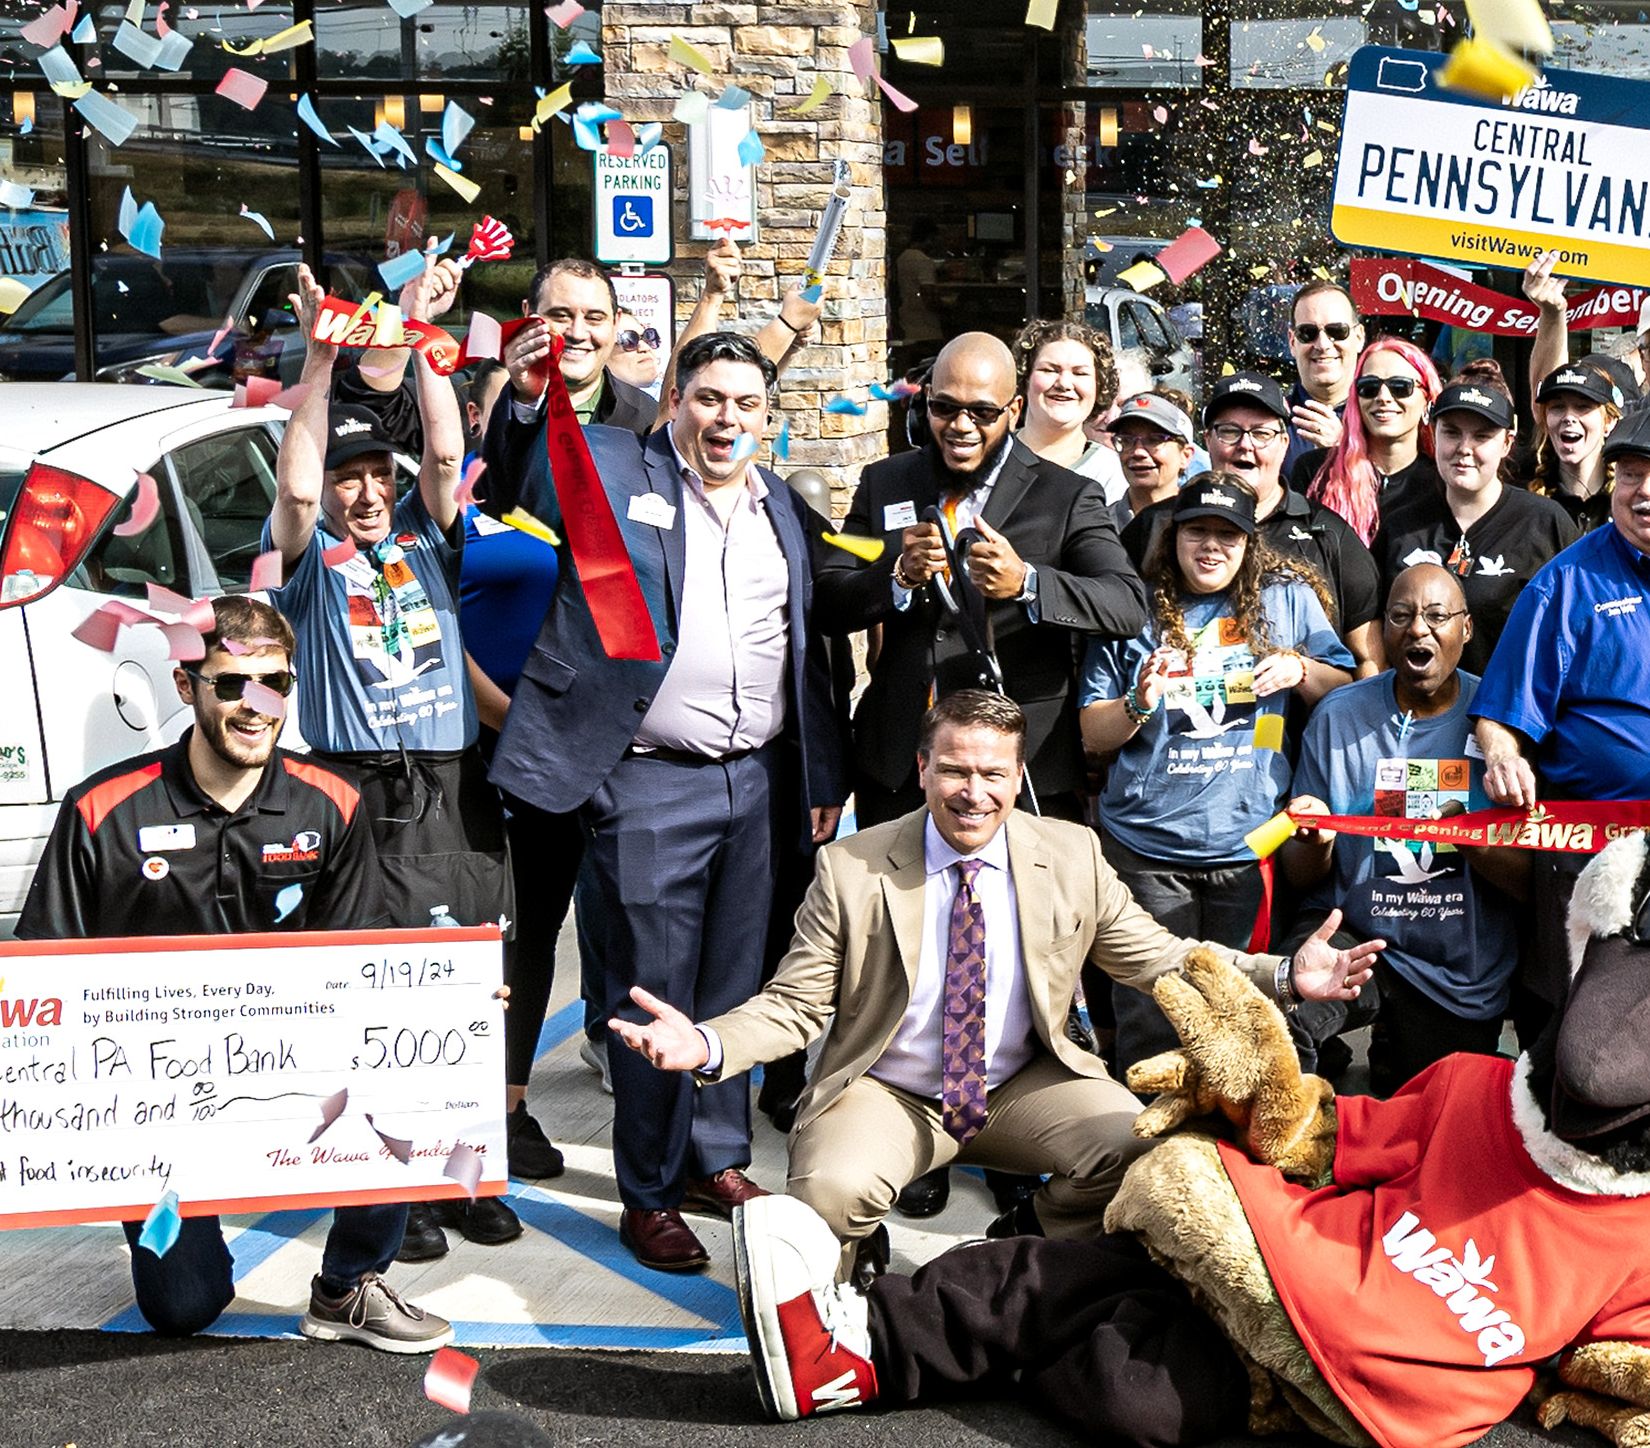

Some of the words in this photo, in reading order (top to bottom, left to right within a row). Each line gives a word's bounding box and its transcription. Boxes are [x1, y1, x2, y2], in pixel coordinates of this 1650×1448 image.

[1502, 84, 1580, 115] Wawa
[1474, 119, 1592, 167] CENTRAL
[599, 153, 666, 170] RESERVED
[604, 175, 662, 190] PARKING
[1451, 231, 1589, 267] visitWawacom
[1486, 820, 1595, 851] Wawa
[1370, 905, 1419, 921] Celebrating
[1420, 906, 1436, 919] 60
[1437, 906, 1465, 921] Years
[1371, 889, 1383, 903] In
[1385, 893, 1404, 906] my
[1406, 890, 1443, 905] Wawa
[1444, 893, 1464, 904] era
[361, 957, 456, 989] 9/19/24
[83, 987, 150, 1003] Fulfilling
[155, 985, 197, 999] Lives,
[202, 984, 242, 999] Every
[246, 982, 276, 996] Day,
[83, 1011, 101, 1028] by
[105, 1008, 168, 1024] Building
[172, 1007, 235, 1022] Stronger
[239, 1001, 336, 1018] Communities
[91, 1036, 133, 1080] PA
[149, 1038, 212, 1080] Food
[224, 1033, 297, 1076] Bank
[0, 1093, 119, 1133] thousand
[134, 1093, 177, 1126] and
[444, 1100, 479, 1111] Dollars
[266, 1148, 302, 1168] The
[310, 1146, 371, 1165] Wawa
[19, 1156, 57, 1187] food
[67, 1154, 173, 1192] insecurity
[1382, 1211, 1526, 1368] Wawa
[811, 1368, 863, 1413] W
